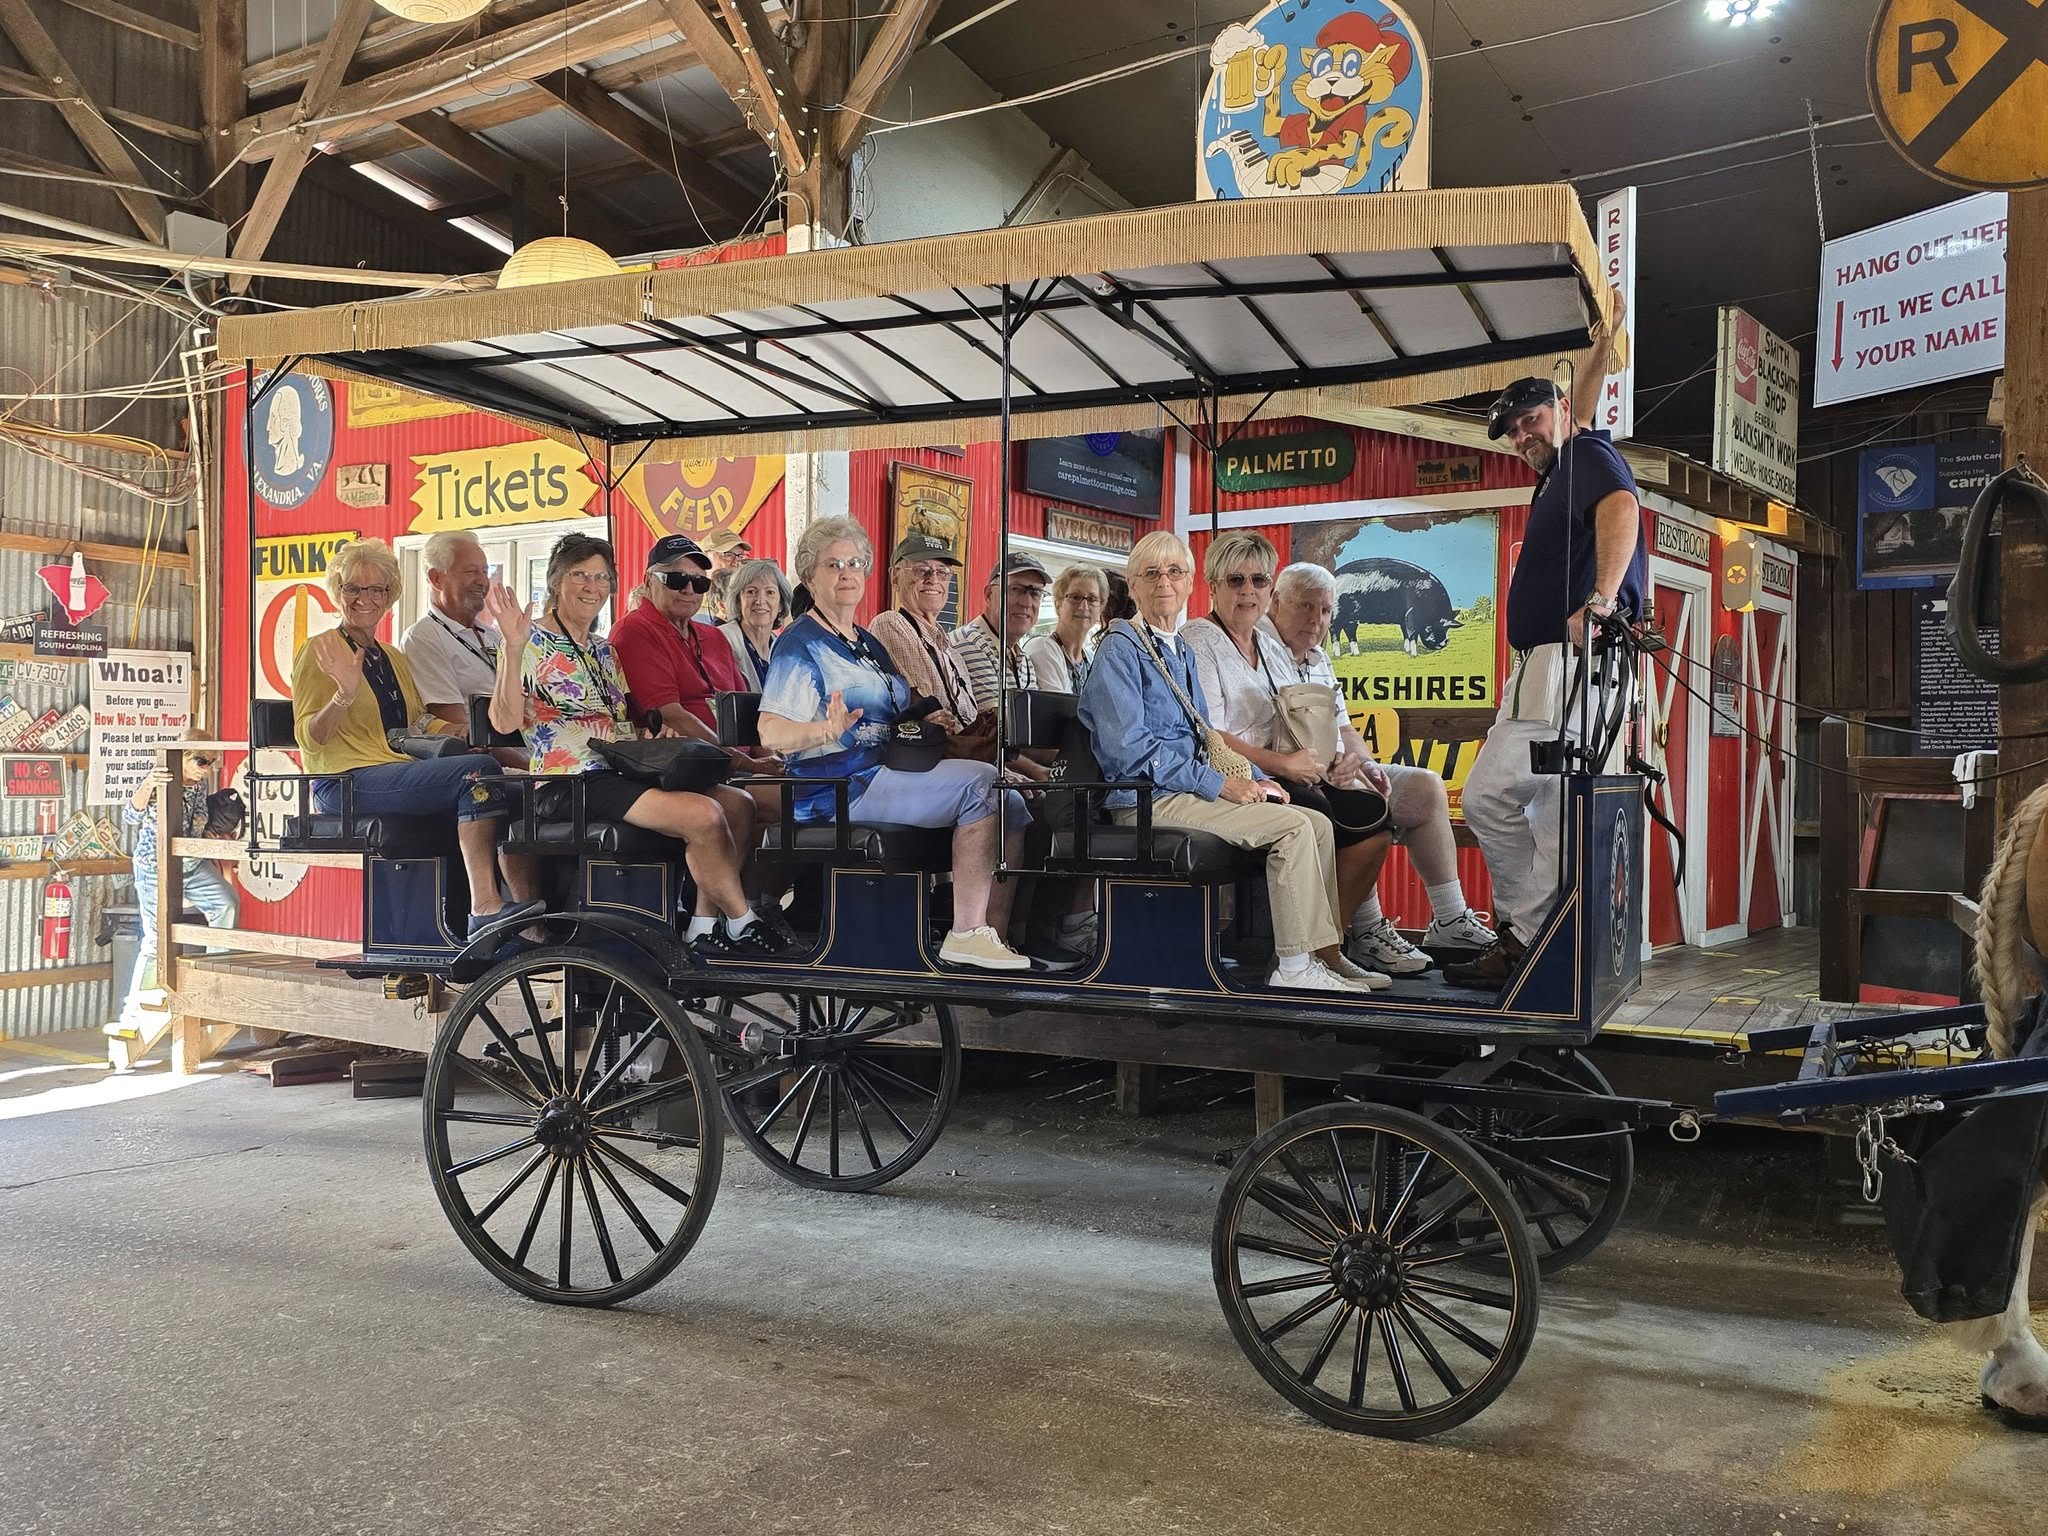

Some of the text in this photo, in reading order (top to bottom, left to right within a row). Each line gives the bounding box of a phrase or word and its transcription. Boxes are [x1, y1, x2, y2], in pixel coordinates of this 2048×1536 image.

[1898, 19, 1959, 93] R
[1836, 219, 2007, 286] HANG OUT HER
[1898, 292, 1933, 319] WE
[1942, 274, 2004, 308] CALL
[1765, 331, 1790, 369] SMITH
[1856, 317, 1998, 369] YOUR NAME
[1757, 355, 1799, 399] BLACKSMITH
[1764, 386, 1787, 416] SHOP
[1754, 410, 1778, 434] GENERAL
[1734, 414, 1796, 472] BLACKSMITH WORK
[1227, 447, 1336, 475] PALMETTO
[1733, 449, 1757, 479] WELDING
[1956, 454, 1981, 462] South
[253, 465, 305, 506] LEXANDRIA.
[306, 459, 323, 482] VA.
[428, 453, 569, 519] Tickets
[1419, 475, 1448, 485] MULES
[660, 486, 734, 532] FEED
[1054, 516, 1129, 552] WELCOME
[1659, 522, 1709, 563] RESTROOM
[1762, 560, 1791, 590] STROOM
[40, 630, 102, 641] REFRESHING
[66, 643, 103, 651] CAROLINA
[98, 662, 182, 684] Whoa!!
[1337, 676, 1486, 700] RKSHIRES
[106, 695, 133, 705] Before
[137, 697, 152, 708] you
[55, 714, 86, 742] 43409
[95, 712, 187, 727] How Was Your Tour?
[100, 746, 112, 756] We
[102, 733, 129, 743] Please
[132, 733, 142, 743] let
[14, 762, 30, 778] NO
[105, 775, 118, 784] But
[106, 760, 153, 773] your satisfa
[8, 780, 60, 794] SMOKING
[105, 788, 133, 800] help to
[250, 860, 283, 879] OIL
